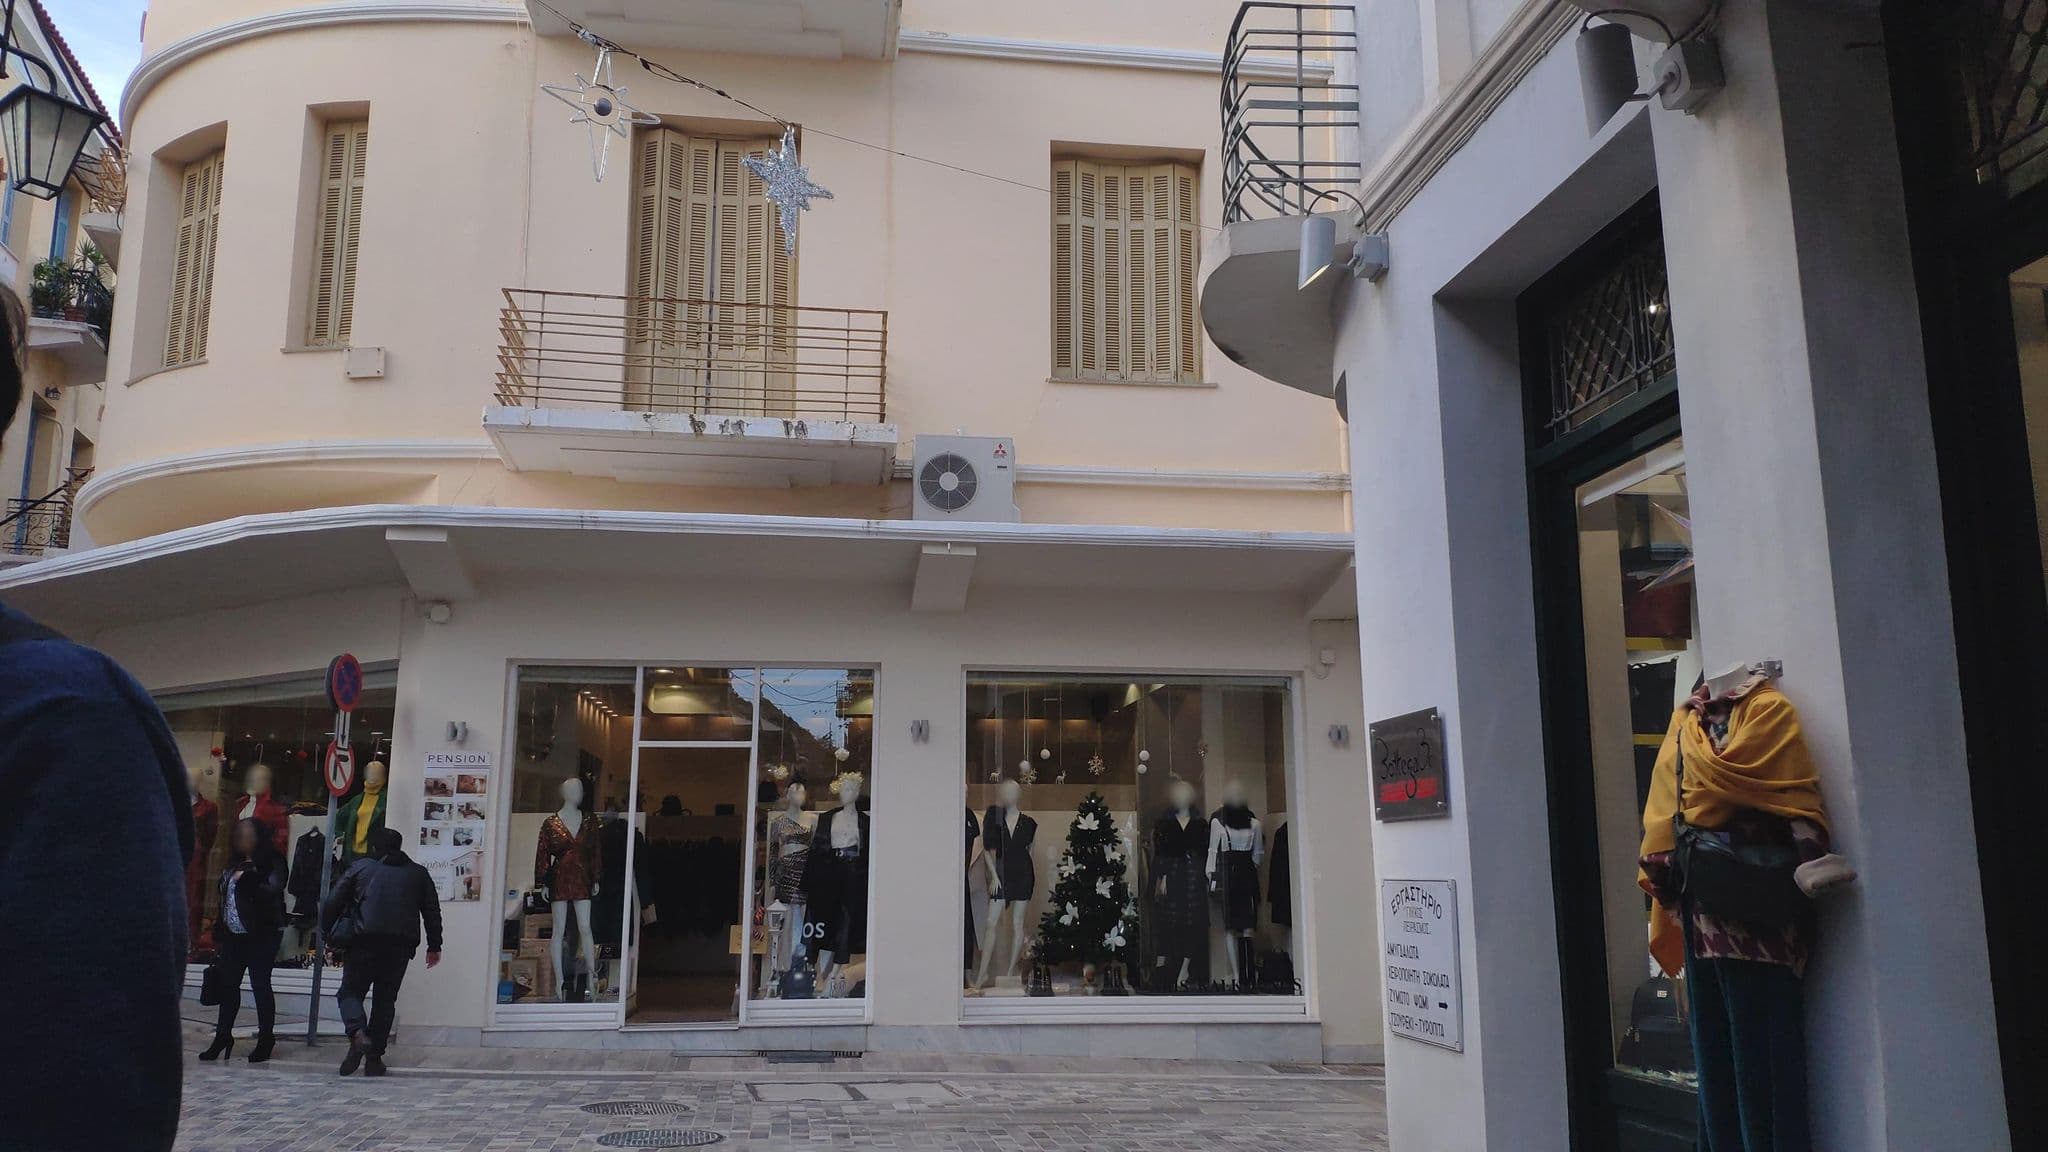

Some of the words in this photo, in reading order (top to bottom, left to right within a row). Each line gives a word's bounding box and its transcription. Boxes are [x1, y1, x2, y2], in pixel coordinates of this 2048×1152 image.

[428, 754, 486, 764] PENSION
[1391, 886, 1442, 919] ΕΡΓΑΣΤΗΡΙΟ
[1423, 970, 1450, 988] ΣΟΚΟΛΑΤΑ
[1414, 994, 1429, 1010] ΨΩΜΙ
